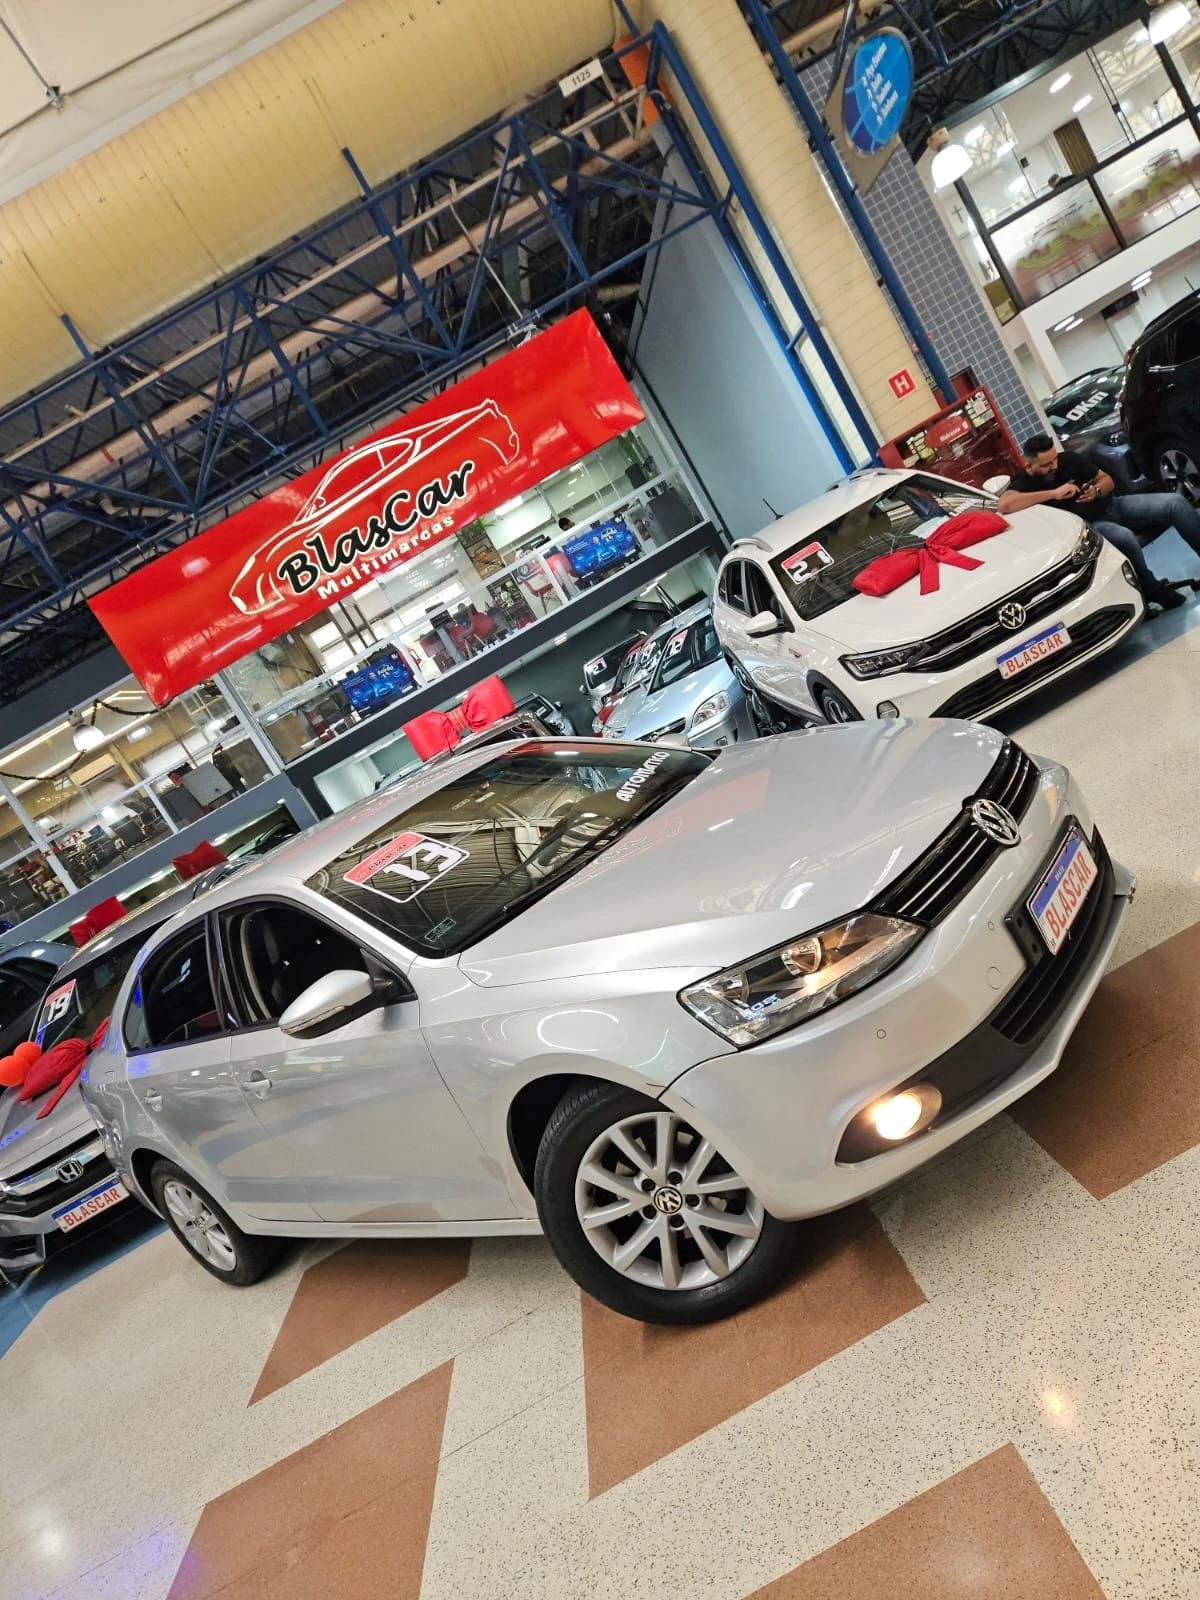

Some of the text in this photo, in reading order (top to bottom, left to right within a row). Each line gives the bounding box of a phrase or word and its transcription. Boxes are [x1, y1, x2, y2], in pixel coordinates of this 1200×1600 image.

[572, 69, 591, 86] 1125
[277, 460, 475, 594] BlasCar
[316, 516, 455, 600] Multimarcas
[1006, 633, 1063, 673] BLASCAR
[382, 842, 462, 882] 13
[1045, 851, 1092, 939] BLASCAR
[48, 992, 70, 1022] 19
[63, 1188, 121, 1226] BLASCAR
